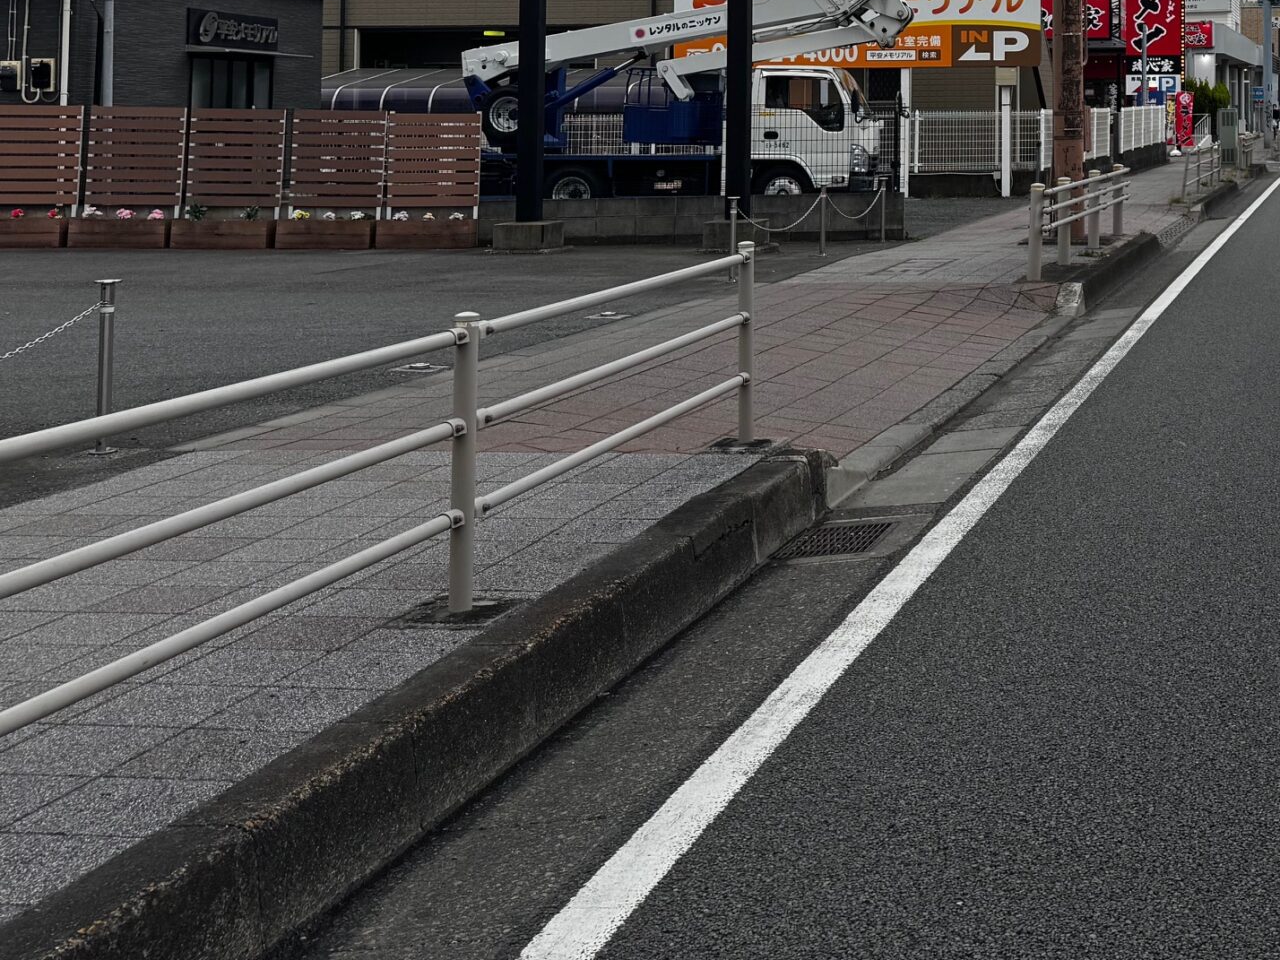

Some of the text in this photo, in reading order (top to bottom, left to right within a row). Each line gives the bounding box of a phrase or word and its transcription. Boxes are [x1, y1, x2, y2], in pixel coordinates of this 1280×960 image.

[649, 16, 721, 36] レンタルのニッケン
[960, 30, 988, 43] IN
[993, 30, 1029, 61] P
[922, 51, 937, 59] 検索
